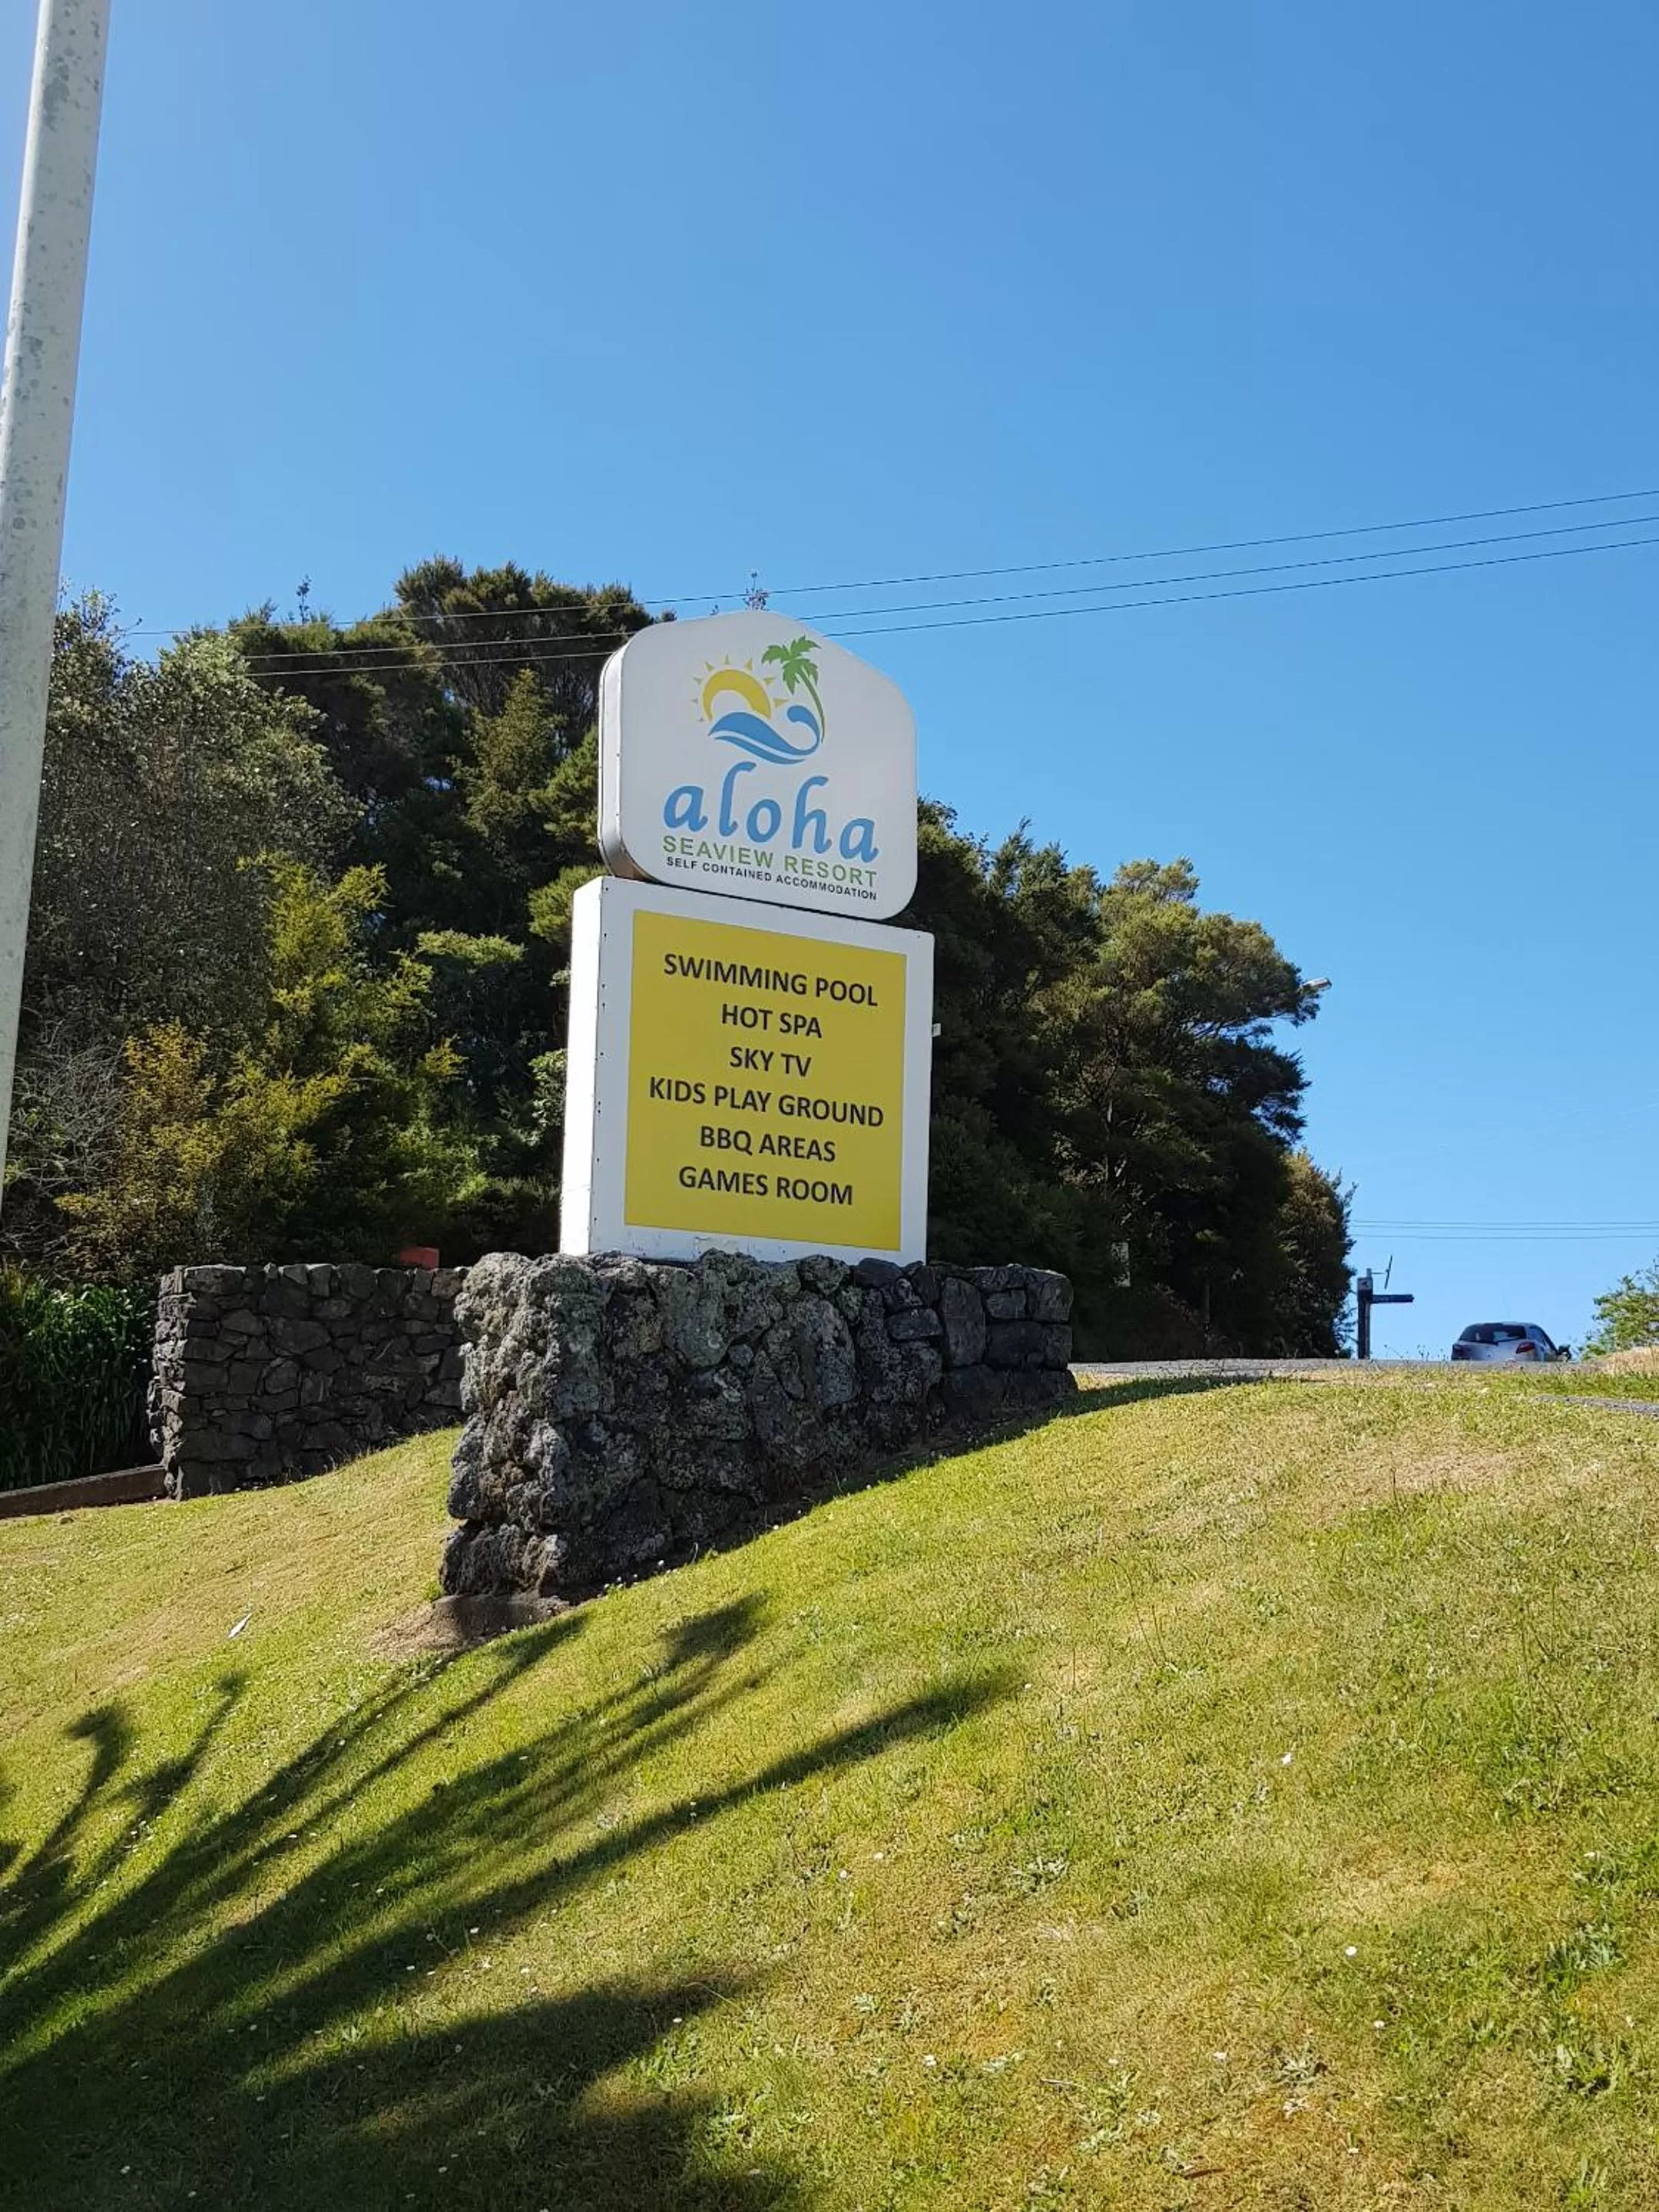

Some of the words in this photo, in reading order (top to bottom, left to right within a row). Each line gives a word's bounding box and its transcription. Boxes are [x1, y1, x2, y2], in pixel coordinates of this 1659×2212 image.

[663, 761, 879, 863] aloha
[662, 835, 774, 869] SEAVIEW
[784, 855, 877, 888] RESORT
[667, 857, 697, 869] SELF
[702, 862, 772, 882] CONTAINED
[776, 875, 878, 901] ACCOMMODATION
[664, 953, 807, 995] SWIMMING
[815, 977, 878, 1007] POOL
[721, 1003, 773, 1031] HOT
[779, 1012, 823, 1038] SPA
[730, 1046, 774, 1071] SKY
[781, 1053, 812, 1077] TV
[650, 1077, 706, 1104] KIDS
[714, 1085, 771, 1113] PLAY
[778, 1094, 884, 1128] GROUND
[700, 1125, 753, 1155] BBQ
[759, 1133, 836, 1162] AREAS
[678, 1166, 769, 1196] GAMES
[776, 1177, 853, 1205] ROOM
